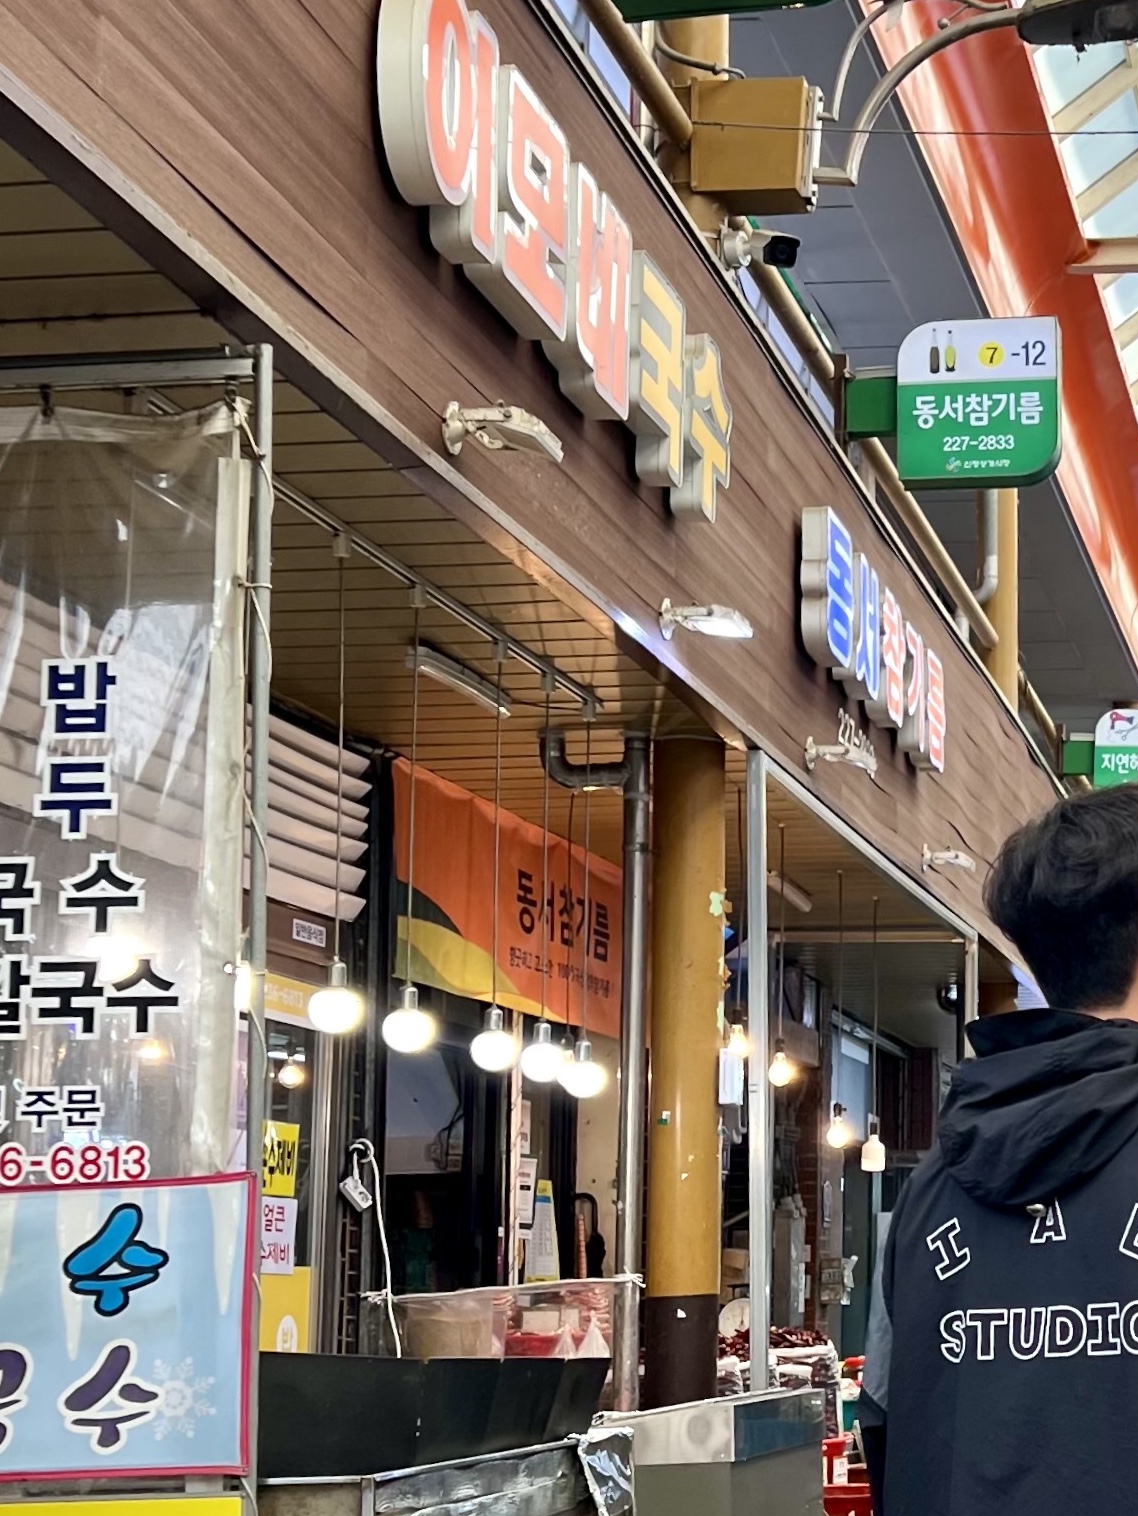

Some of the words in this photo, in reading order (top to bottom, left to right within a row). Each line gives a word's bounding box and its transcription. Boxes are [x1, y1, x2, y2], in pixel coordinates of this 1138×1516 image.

[913, 391, 1044, 429] 동서참기름
[943, 435, 1015, 452] 227-2833
[517, 869, 610, 963] 동서참기름
[20, 1090, 101, 1130] 주문
